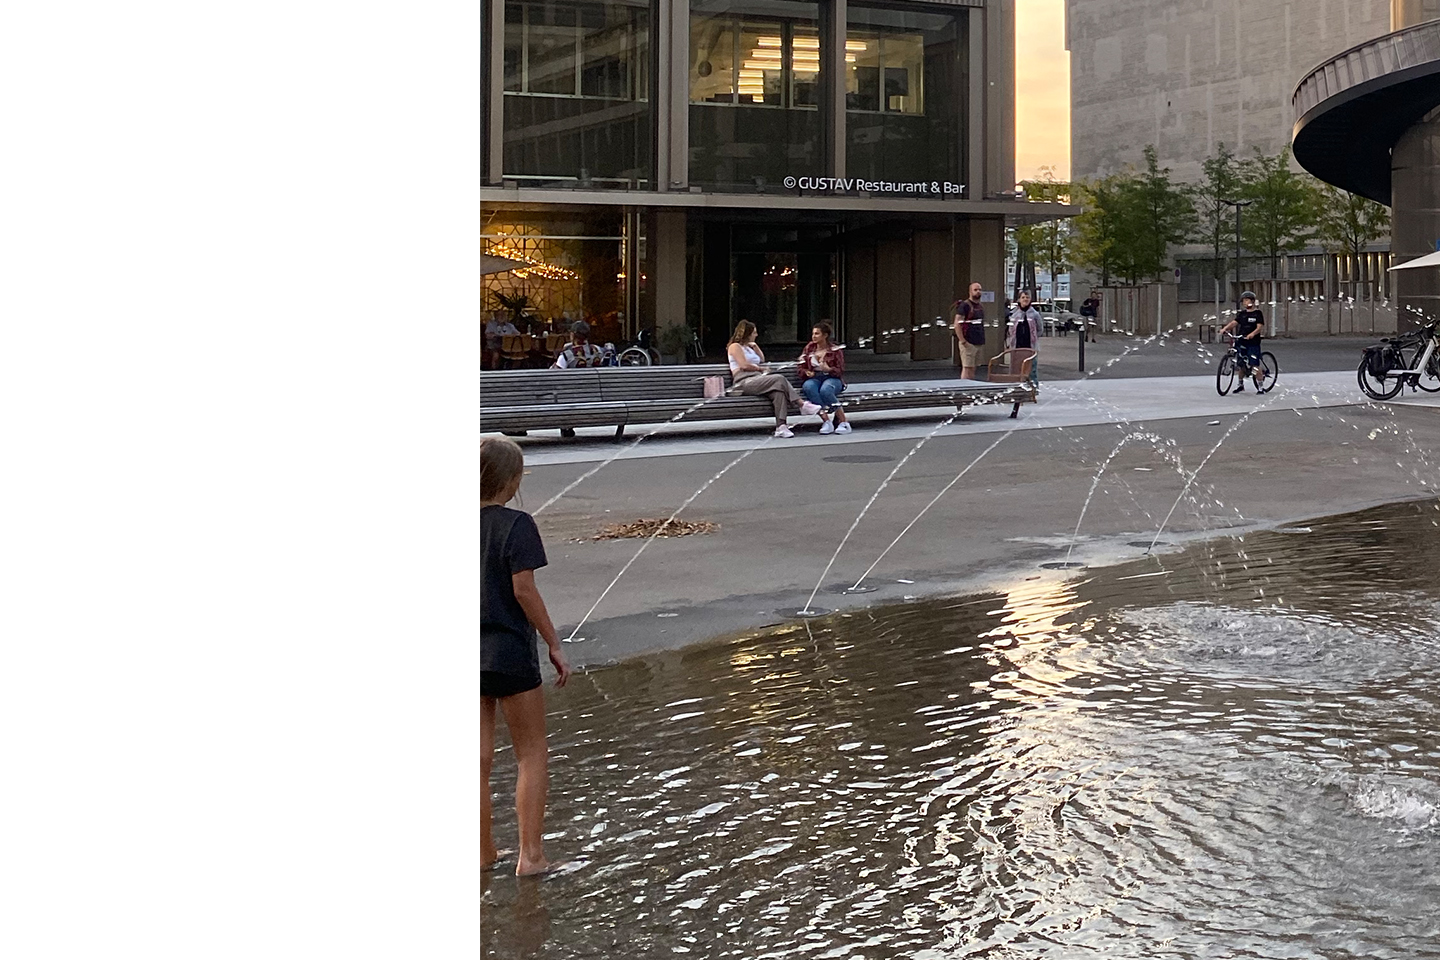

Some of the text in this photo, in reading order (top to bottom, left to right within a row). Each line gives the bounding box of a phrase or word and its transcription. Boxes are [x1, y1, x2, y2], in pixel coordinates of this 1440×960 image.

[798, 176, 854, 190] GUSTAV
[856, 179, 928, 193] Restaurant
[930, 181, 941, 193] &
[943, 181, 966, 194] Bar
